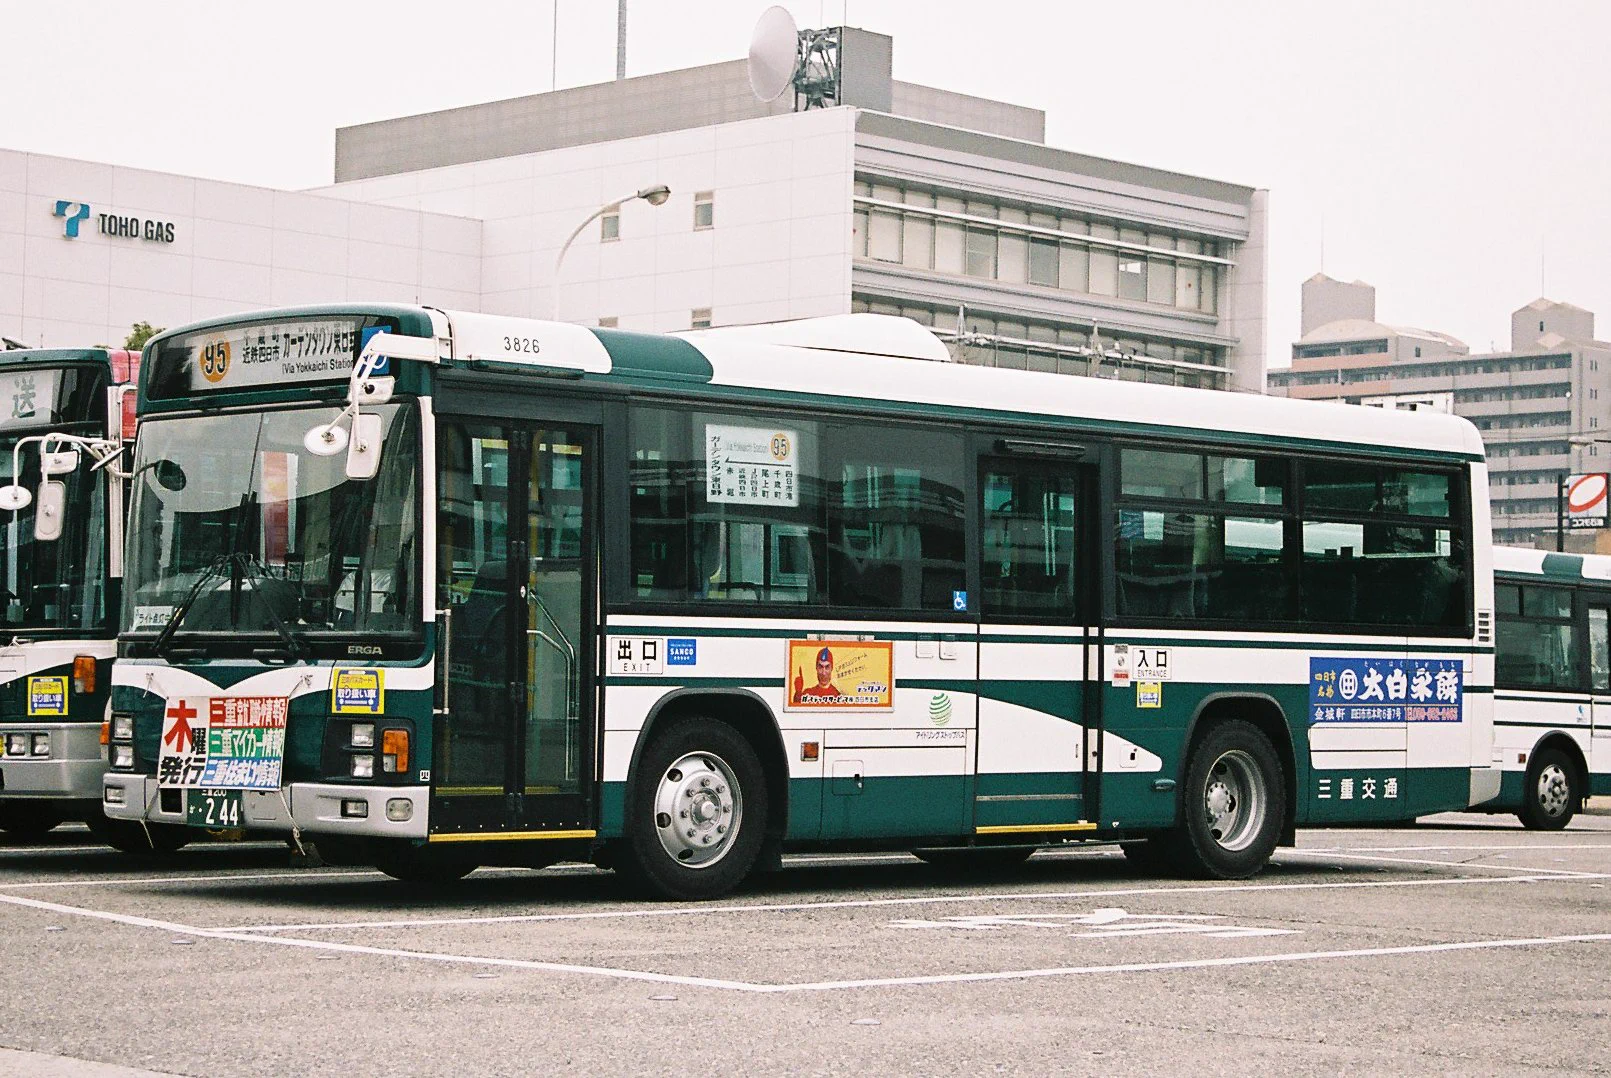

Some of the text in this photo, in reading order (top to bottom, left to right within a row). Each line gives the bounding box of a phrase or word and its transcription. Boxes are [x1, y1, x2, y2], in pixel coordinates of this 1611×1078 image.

[99, 213, 175, 243] TOHO GAS
[242, 345, 280, 364] 近鉄四日市
[503, 336, 540, 354] 3826
[205, 341, 226, 374] 95
[296, 361, 328, 374] Yokkaichi
[12, 375, 36, 419] 送
[773, 438, 787, 457] 95
[347, 645, 383, 655] ERGA
[617, 639, 657, 661] 出口
[669, 648, 694, 656] SANCO
[1137, 649, 1168, 668] 入口
[623, 662, 651, 672] EXIT
[1137, 669, 1168, 678] ENTRANCE
[1314, 670, 1337, 684] 四日市
[1358, 667, 1460, 704] 太白永餅
[210, 698, 286, 727] 三重就職情報
[1314, 707, 1346, 721] 金城軒
[209, 728, 282, 758] 三重マイカー情報
[159, 755, 207, 785] 発行
[1317, 777, 1398, 800] 三重交通
